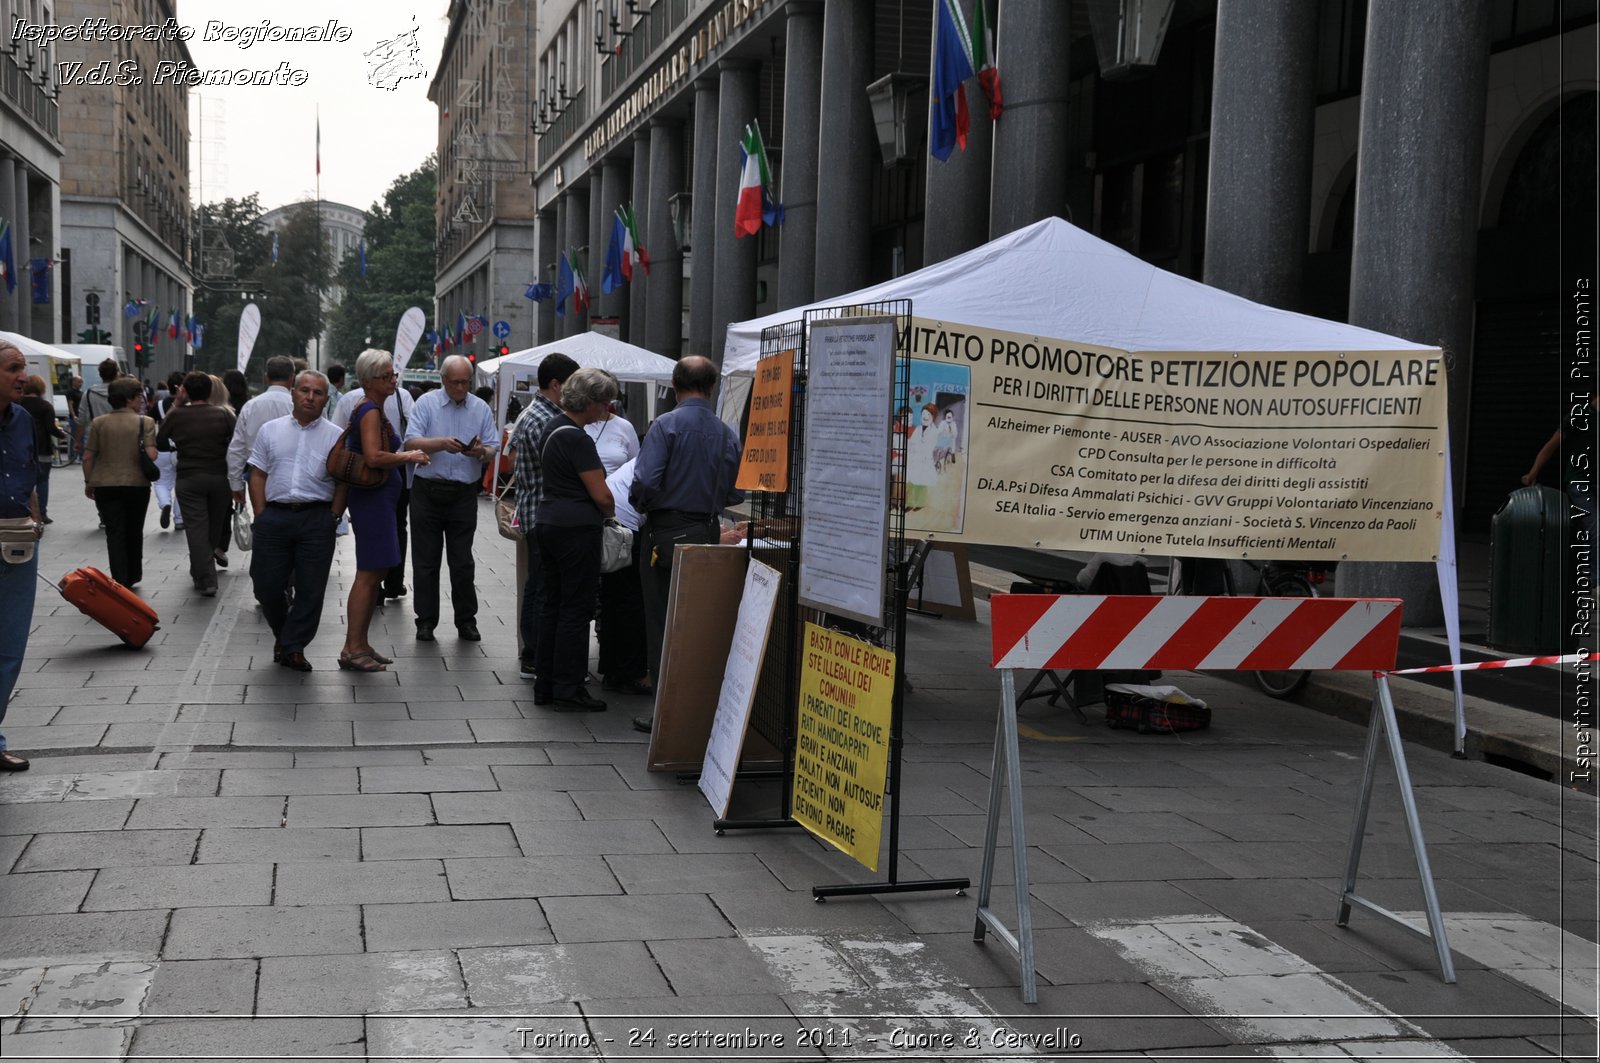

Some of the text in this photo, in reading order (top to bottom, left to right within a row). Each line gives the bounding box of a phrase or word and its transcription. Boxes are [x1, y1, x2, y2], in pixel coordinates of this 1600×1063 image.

[584, 124, 605, 160] BANCA
[607, 46, 688, 141] INTERMOBILIARE
[691, 28, 706, 67] DI
[452, 79, 483, 223] ZARA
[990, 338, 1144, 383] PROMOTORE
[1151, 358, 1288, 387] PETIZIONE
[1293, 358, 1441, 388] POPOLARE
[752, 396, 762, 411] PER
[993, 375, 1423, 417] PER I DIRITTI DELLE PERSONE NON AUTOSUFFICIENTI
[987, 416, 1051, 435] Alzheimer
[1053, 424, 1111, 441] Piemonte
[1120, 431, 1162, 445] AUSER
[1171, 434, 1201, 446] AVO
[1204, 435, 1289, 450] Associazione
[1292, 436, 1356, 450] Volontari
[1358, 436, 1431, 451] Ospedalieri
[745, 448, 759, 463] VERO
[1078, 447, 1337, 470] CPD Consulta per le persone in difficoltà
[976, 477, 1027, 494] Di.A.Psi
[1029, 482, 1069, 498] Difesa
[1071, 486, 1135, 503] Ammalati
[1137, 490, 1184, 506] Psichici
[1193, 494, 1225, 507] GVV
[1227, 494, 1273, 511] Gruppi
[1276, 496, 1359, 510] Volontariato
[1361, 497, 1434, 511] Vincenziano
[1050, 464, 1369, 492] CSA Comitato per la difesa dei diritti degli assistiti
[995, 500, 1020, 514] SEA
[1023, 502, 1056, 517] Italia
[1066, 506, 1106, 522] Servio
[1108, 512, 1179, 526] emergenza
[1182, 515, 1233, 527] anziani
[1243, 515, 1292, 529] Società
[1295, 516, 1306, 529] S.
[1309, 517, 1366, 530] Vincenzo
[1368, 517, 1384, 530] da
[1386, 518, 1418, 531] Paoli
[1079, 528, 1337, 549] UTIM Unione Tutela Insufficienti Mentali
[810, 631, 833, 655] BASTA
[834, 640, 850, 661] CON
[851, 647, 862, 666] LE
[808, 652, 872, 693] STE ILLEGALI DEI
[807, 694, 836, 723] PARENTI
[837, 707, 852, 729] DEI
[800, 734, 858, 778] GRAVI E ANZIANI
[801, 713, 870, 763] RATI HANDICAPPATI
[798, 753, 823, 782] MALATI
[825, 768, 841, 792] NON
[797, 774, 846, 817] FICIENTI NON
[795, 794, 856, 846] DEVONO PAGARE
